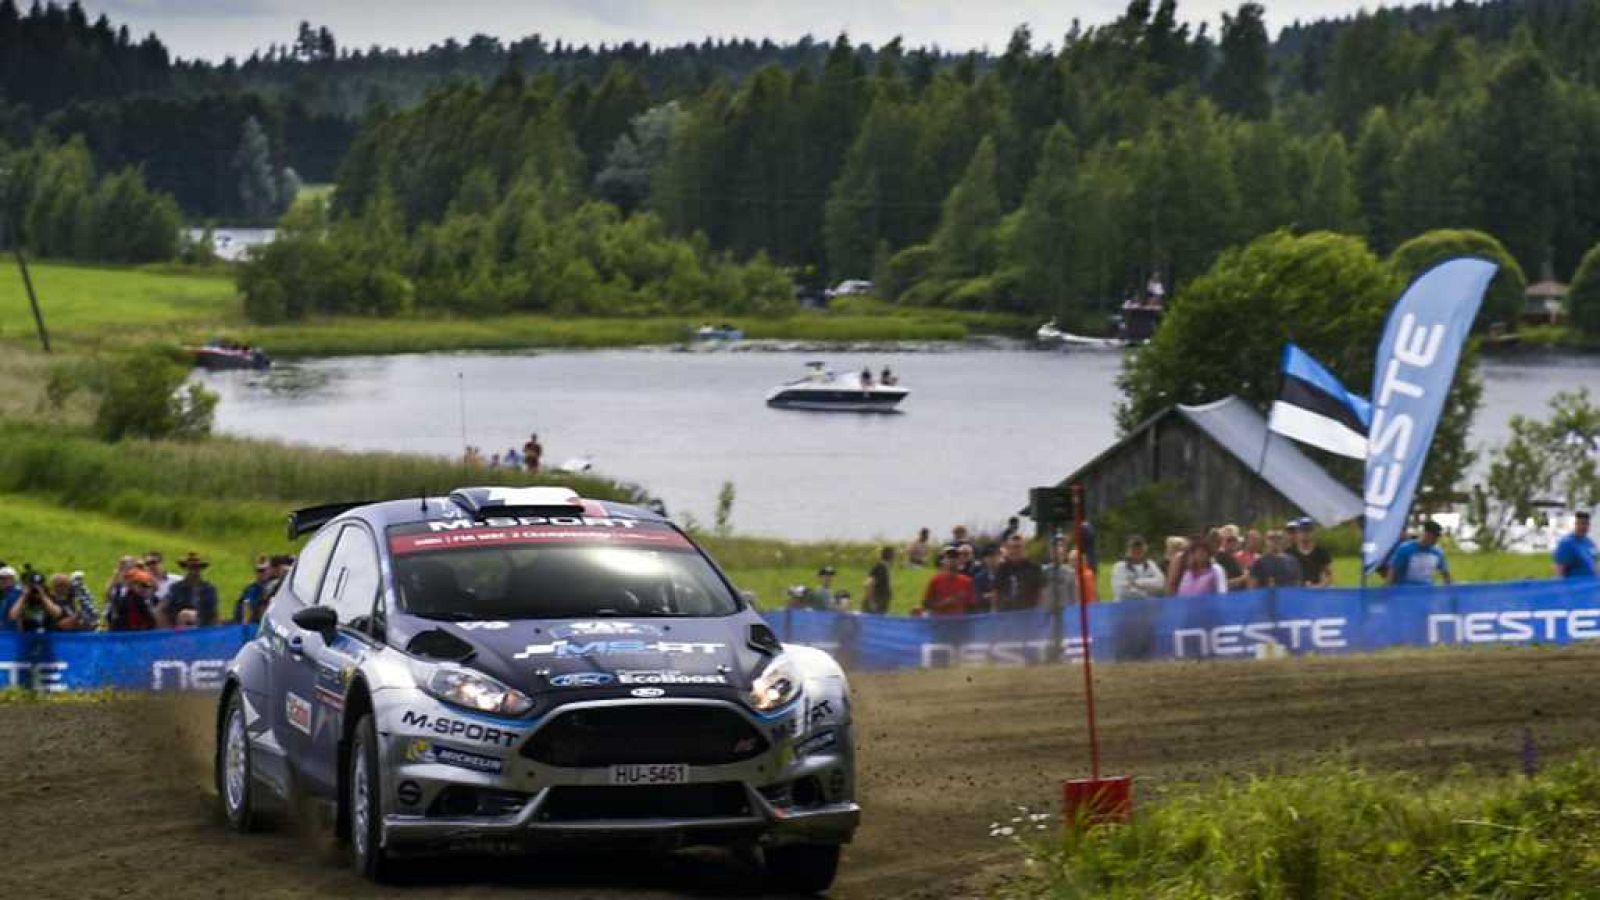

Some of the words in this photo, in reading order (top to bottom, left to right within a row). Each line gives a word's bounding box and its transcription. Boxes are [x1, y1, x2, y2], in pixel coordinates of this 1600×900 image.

[428, 516, 638, 531] M-SPORT
[1174, 618, 1348, 657] NESTE
[1426, 609, 1600, 644] NESTE
[618, 673, 727, 684] EcoBoost
[401, 710, 518, 746] M-SPORT
